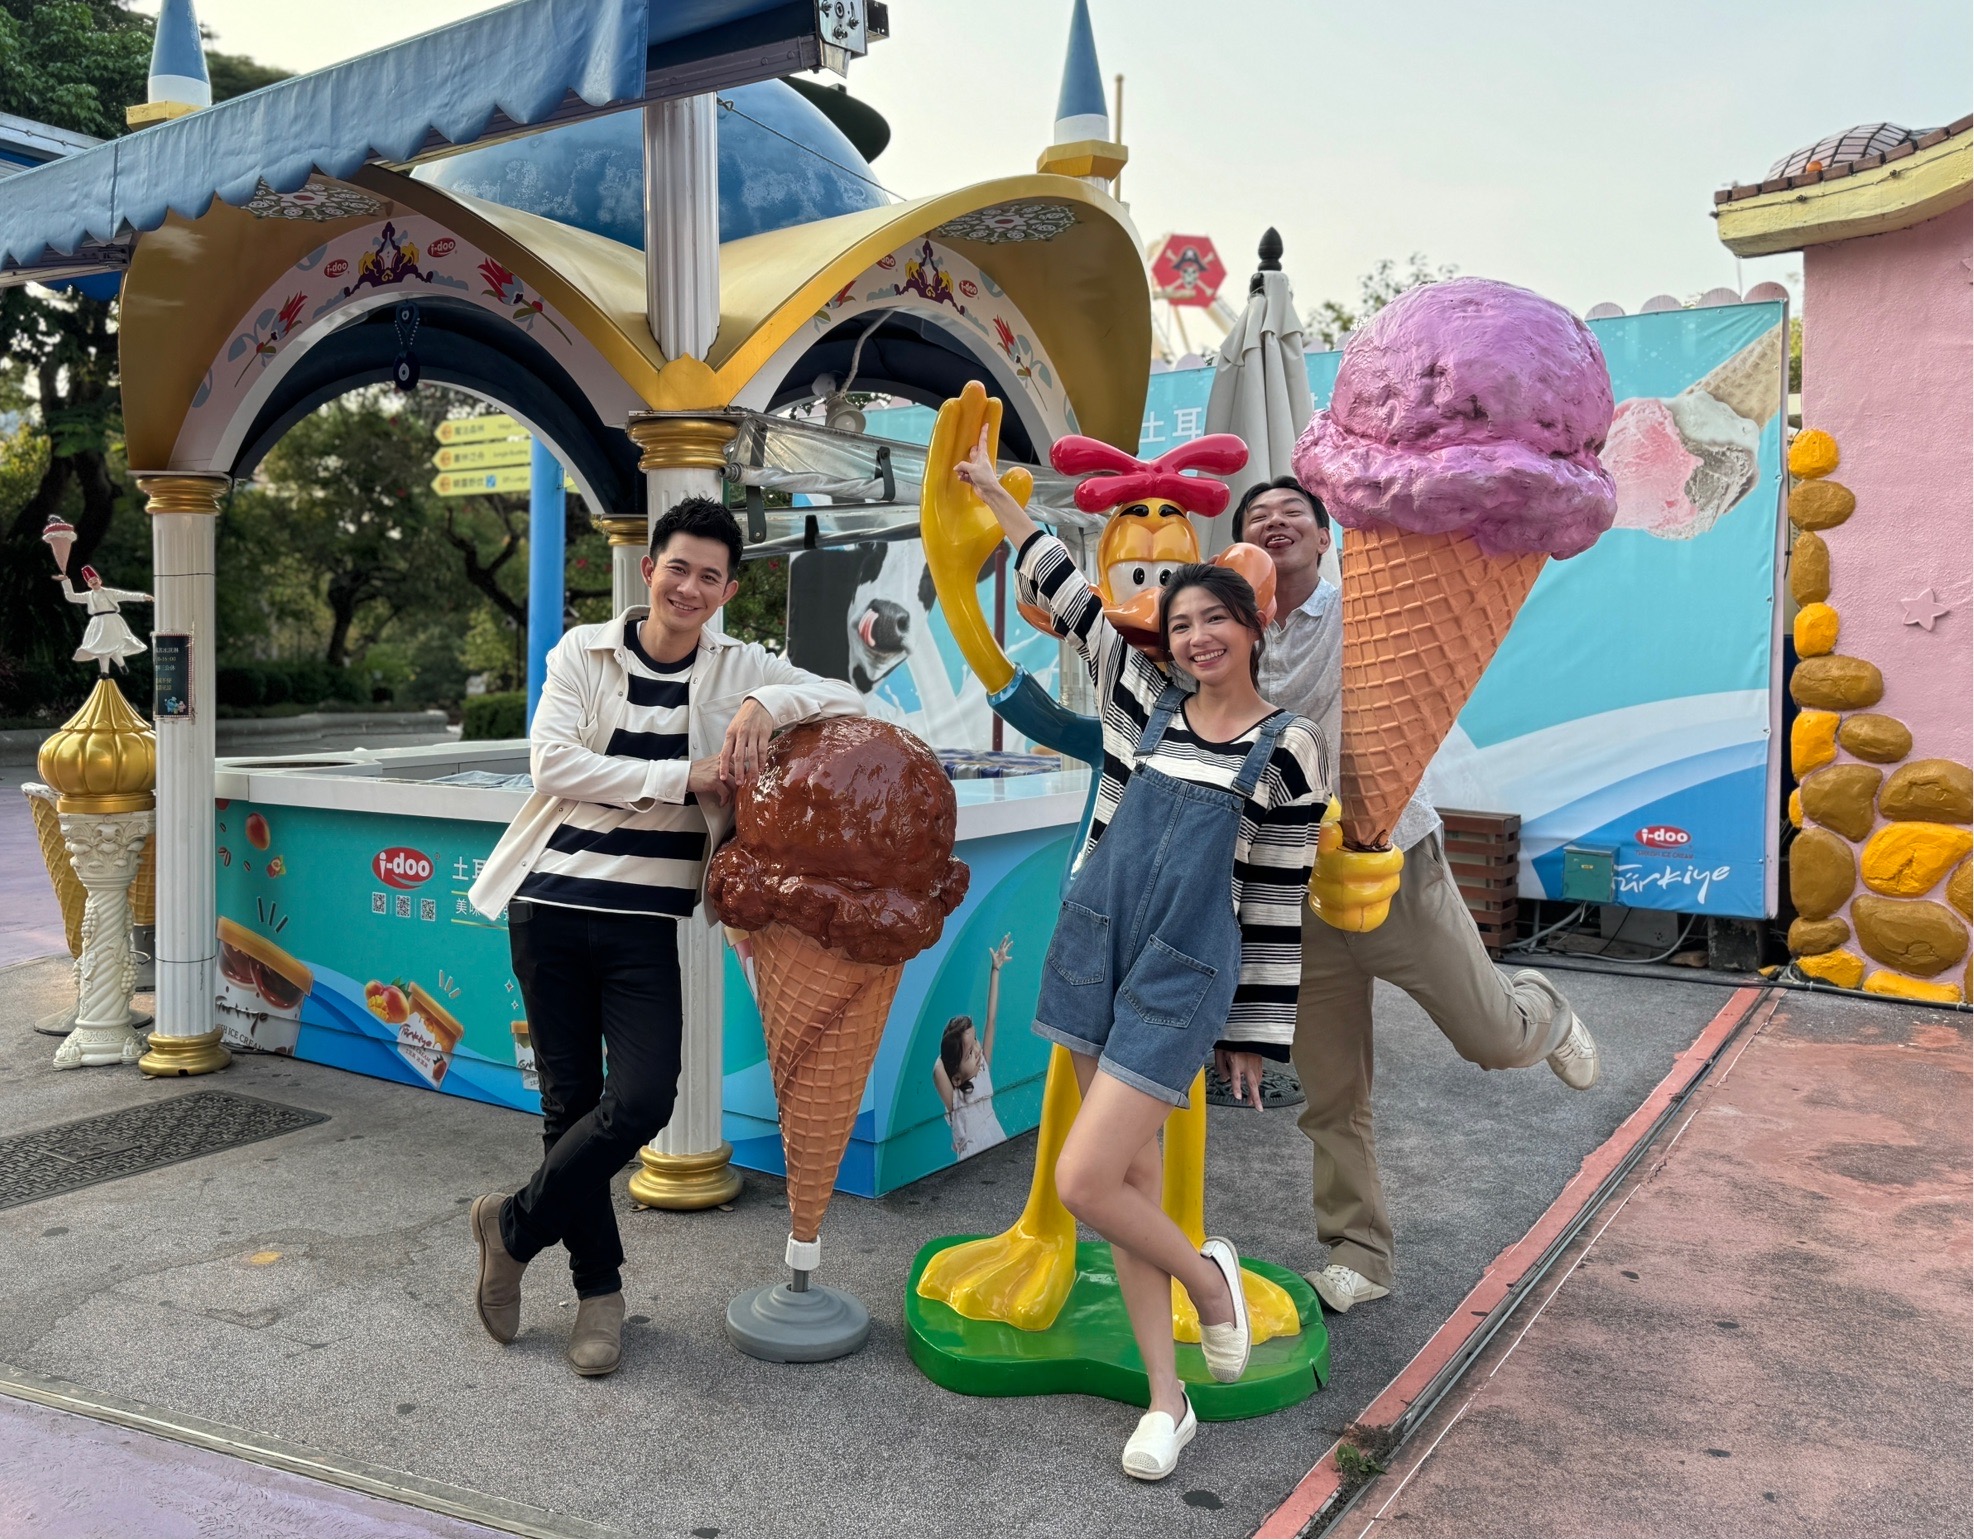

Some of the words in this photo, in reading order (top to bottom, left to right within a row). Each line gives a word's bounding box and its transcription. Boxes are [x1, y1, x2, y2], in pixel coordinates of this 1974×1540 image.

[430, 241, 454, 253] i-doo
[326, 262, 347, 273] i-doo
[1641, 828, 1689, 845] i-doo
[379, 851, 430, 880] i-doo
[228, 1026, 239, 1039] ICE
